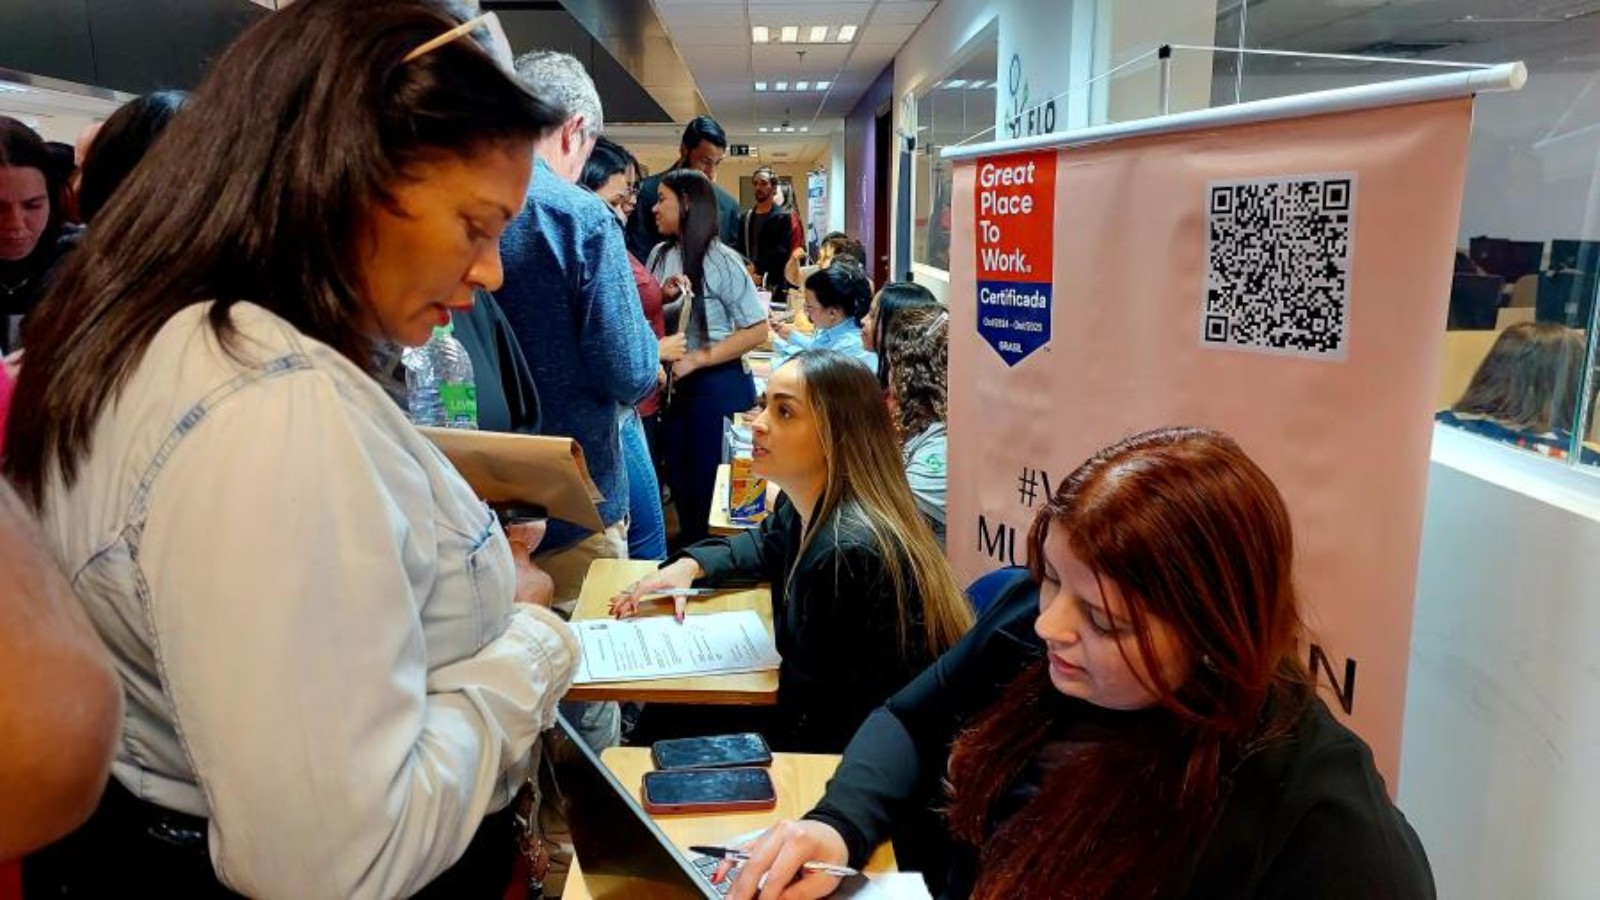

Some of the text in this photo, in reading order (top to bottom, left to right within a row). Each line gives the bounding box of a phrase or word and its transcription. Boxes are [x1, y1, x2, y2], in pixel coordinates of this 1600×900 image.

[980, 161, 1036, 188] Great
[980, 190, 1033, 216] Place
[980, 220, 1000, 243] To
[980, 287, 1046, 308] Certificada
[999, 341, 1023, 353] BRASIL
